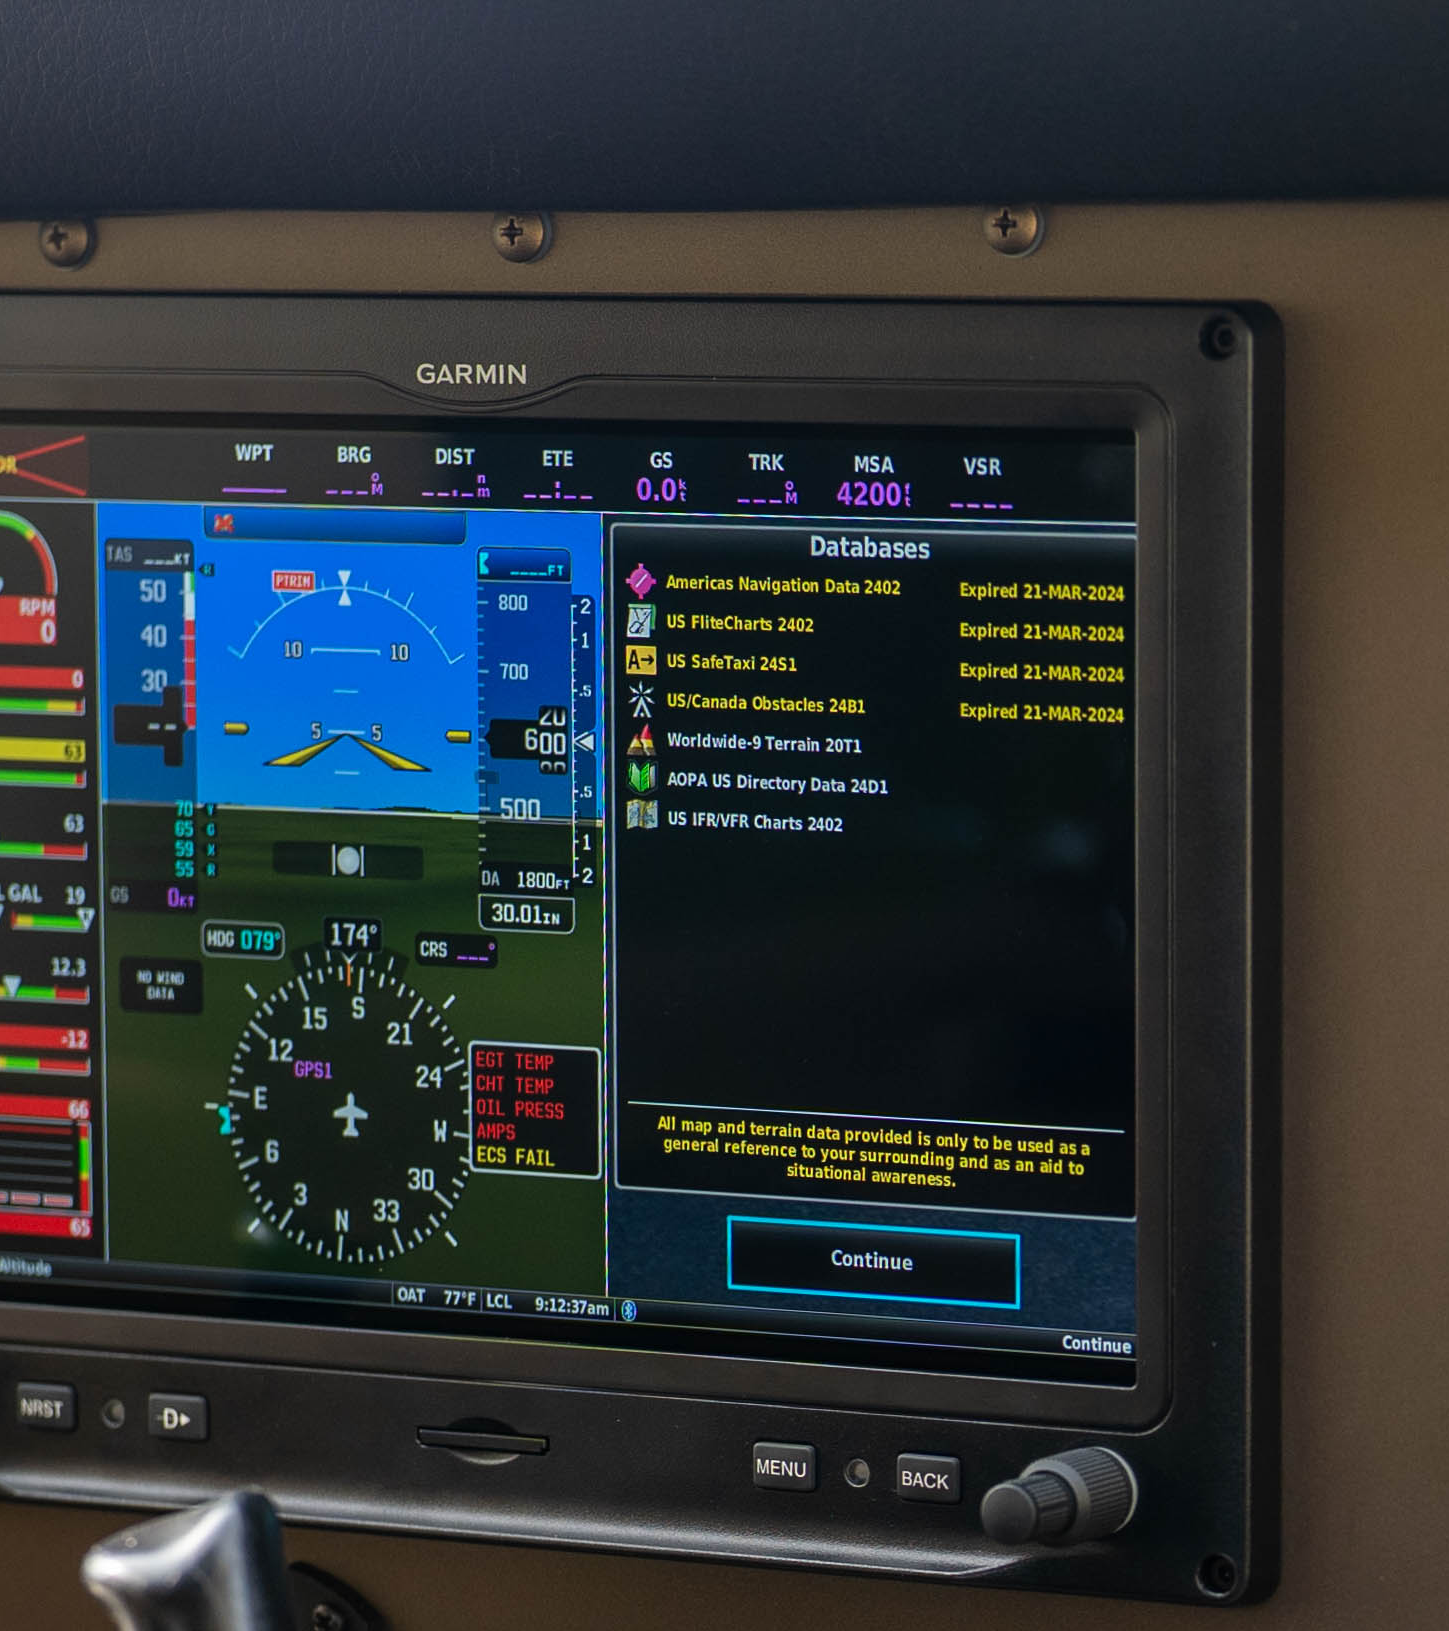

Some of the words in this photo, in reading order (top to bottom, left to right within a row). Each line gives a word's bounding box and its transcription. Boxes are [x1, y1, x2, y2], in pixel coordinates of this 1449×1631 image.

[416, 363, 527, 384] GARMIN
[235, 444, 273, 462] WPT
[337, 446, 371, 463] BRG
[435, 449, 475, 465] DIST
[542, 450, 573, 466] ETE
[650, 451, 673, 470] GS
[749, 454, 785, 472] TRK
[854, 455, 894, 474] MSA
[963, 457, 1001, 476] VSR
[809, 535, 931, 560] Databases
[666, 574, 734, 592] Americas
[738, 575, 819, 595] Navigation
[824, 577, 861, 594] Data
[863, 578, 901, 596] 2402
[959, 581, 1018, 601] Expired
[1023, 583, 1125, 602] 21-MAR-2024
[20, 598, 55, 616] RPM
[667, 613, 686, 630] US
[691, 613, 773, 634] FliteCharts
[777, 616, 814, 634] 2402
[959, 622, 1018, 642] Expired
[1023, 624, 1125, 643] 21-MAR-2024
[667, 653, 686, 671] US
[691, 653, 756, 672] SafeTaxi
[759, 656, 798, 673] 24S1
[959, 662, 1018, 682] Expired
[1023, 664, 1125, 684] 21-MAR-2024
[667, 693, 747, 711] US/Canada
[752, 695, 825, 714] Obstacles
[828, 697, 865, 714] 24B1
[959, 703, 1018, 722] Expired
[1023, 705, 1125, 724] 21-MAR-2024
[667, 732, 762, 751] Worldwide-9
[765, 734, 820, 753] Terrain
[825, 737, 862, 754] 20T1
[667, 772, 707, 788] AOPA
[712, 773, 731, 789] US
[736, 774, 806, 795] Directory
[810, 777, 846, 793] Data
[850, 778, 888, 795] 24D1
[668, 811, 687, 827] US
[692, 812, 749, 830] IFR/VFR
[754, 814, 803, 831] Charts
[807, 816, 843, 833] 2402
[8, 884, 42, 903] GAL
[206, 930, 235, 948] HDG
[420, 940, 448, 958] CRS
[476, 1051, 504, 1069] EGT
[515, 1053, 554, 1071] TEMP
[476, 1075, 504, 1092] CHT
[515, 1077, 554, 1095] TEMP
[476, 1099, 505, 1117] OIL
[515, 1101, 564, 1120] PRESS
[476, 1123, 516, 1141] AMPS
[658, 1116, 677, 1132] All
[681, 1119, 713, 1137] map
[718, 1119, 746, 1136] and
[750, 1121, 802, 1139] terrain
[806, 1124, 840, 1142] data
[844, 1127, 913, 1147] provided
[917, 1131, 931, 1146] is
[936, 1132, 968, 1152] only
[973, 1135, 989, 1150] to
[993, 1136, 1012, 1152] be
[1017, 1137, 1053, 1154] used
[1058, 1141, 1077, 1155] as
[1080, 1143, 1091, 1156] a
[477, 1145, 507, 1164] ECS
[515, 1147, 555, 1167] FAIL
[663, 1137, 719, 1156] general
[724, 1139, 797, 1159] reference
[801, 1144, 816, 1160] to
[820, 1148, 855, 1165] your
[859, 1146, 955, 1171] surrounding
[959, 1153, 989, 1170] and
[993, 1157, 1011, 1171] as
[1015, 1158, 1035, 1173] an
[1039, 1157, 1063, 1174] aid
[1068, 1160, 1085, 1175] to
[787, 1163, 866, 1182] situational
[871, 1168, 956, 1188] awareness.
[831, 1249, 913, 1272] Continue
[398, 1286, 426, 1304] OAT
[486, 1293, 513, 1310] LCL
[535, 1297, 609, 1317] 9:12:37am
[1062, 1335, 1132, 1355] Continue
[20, 1398, 64, 1420] NRST
[756, 1458, 808, 1480] MENU
[901, 1470, 949, 1490] BACK
